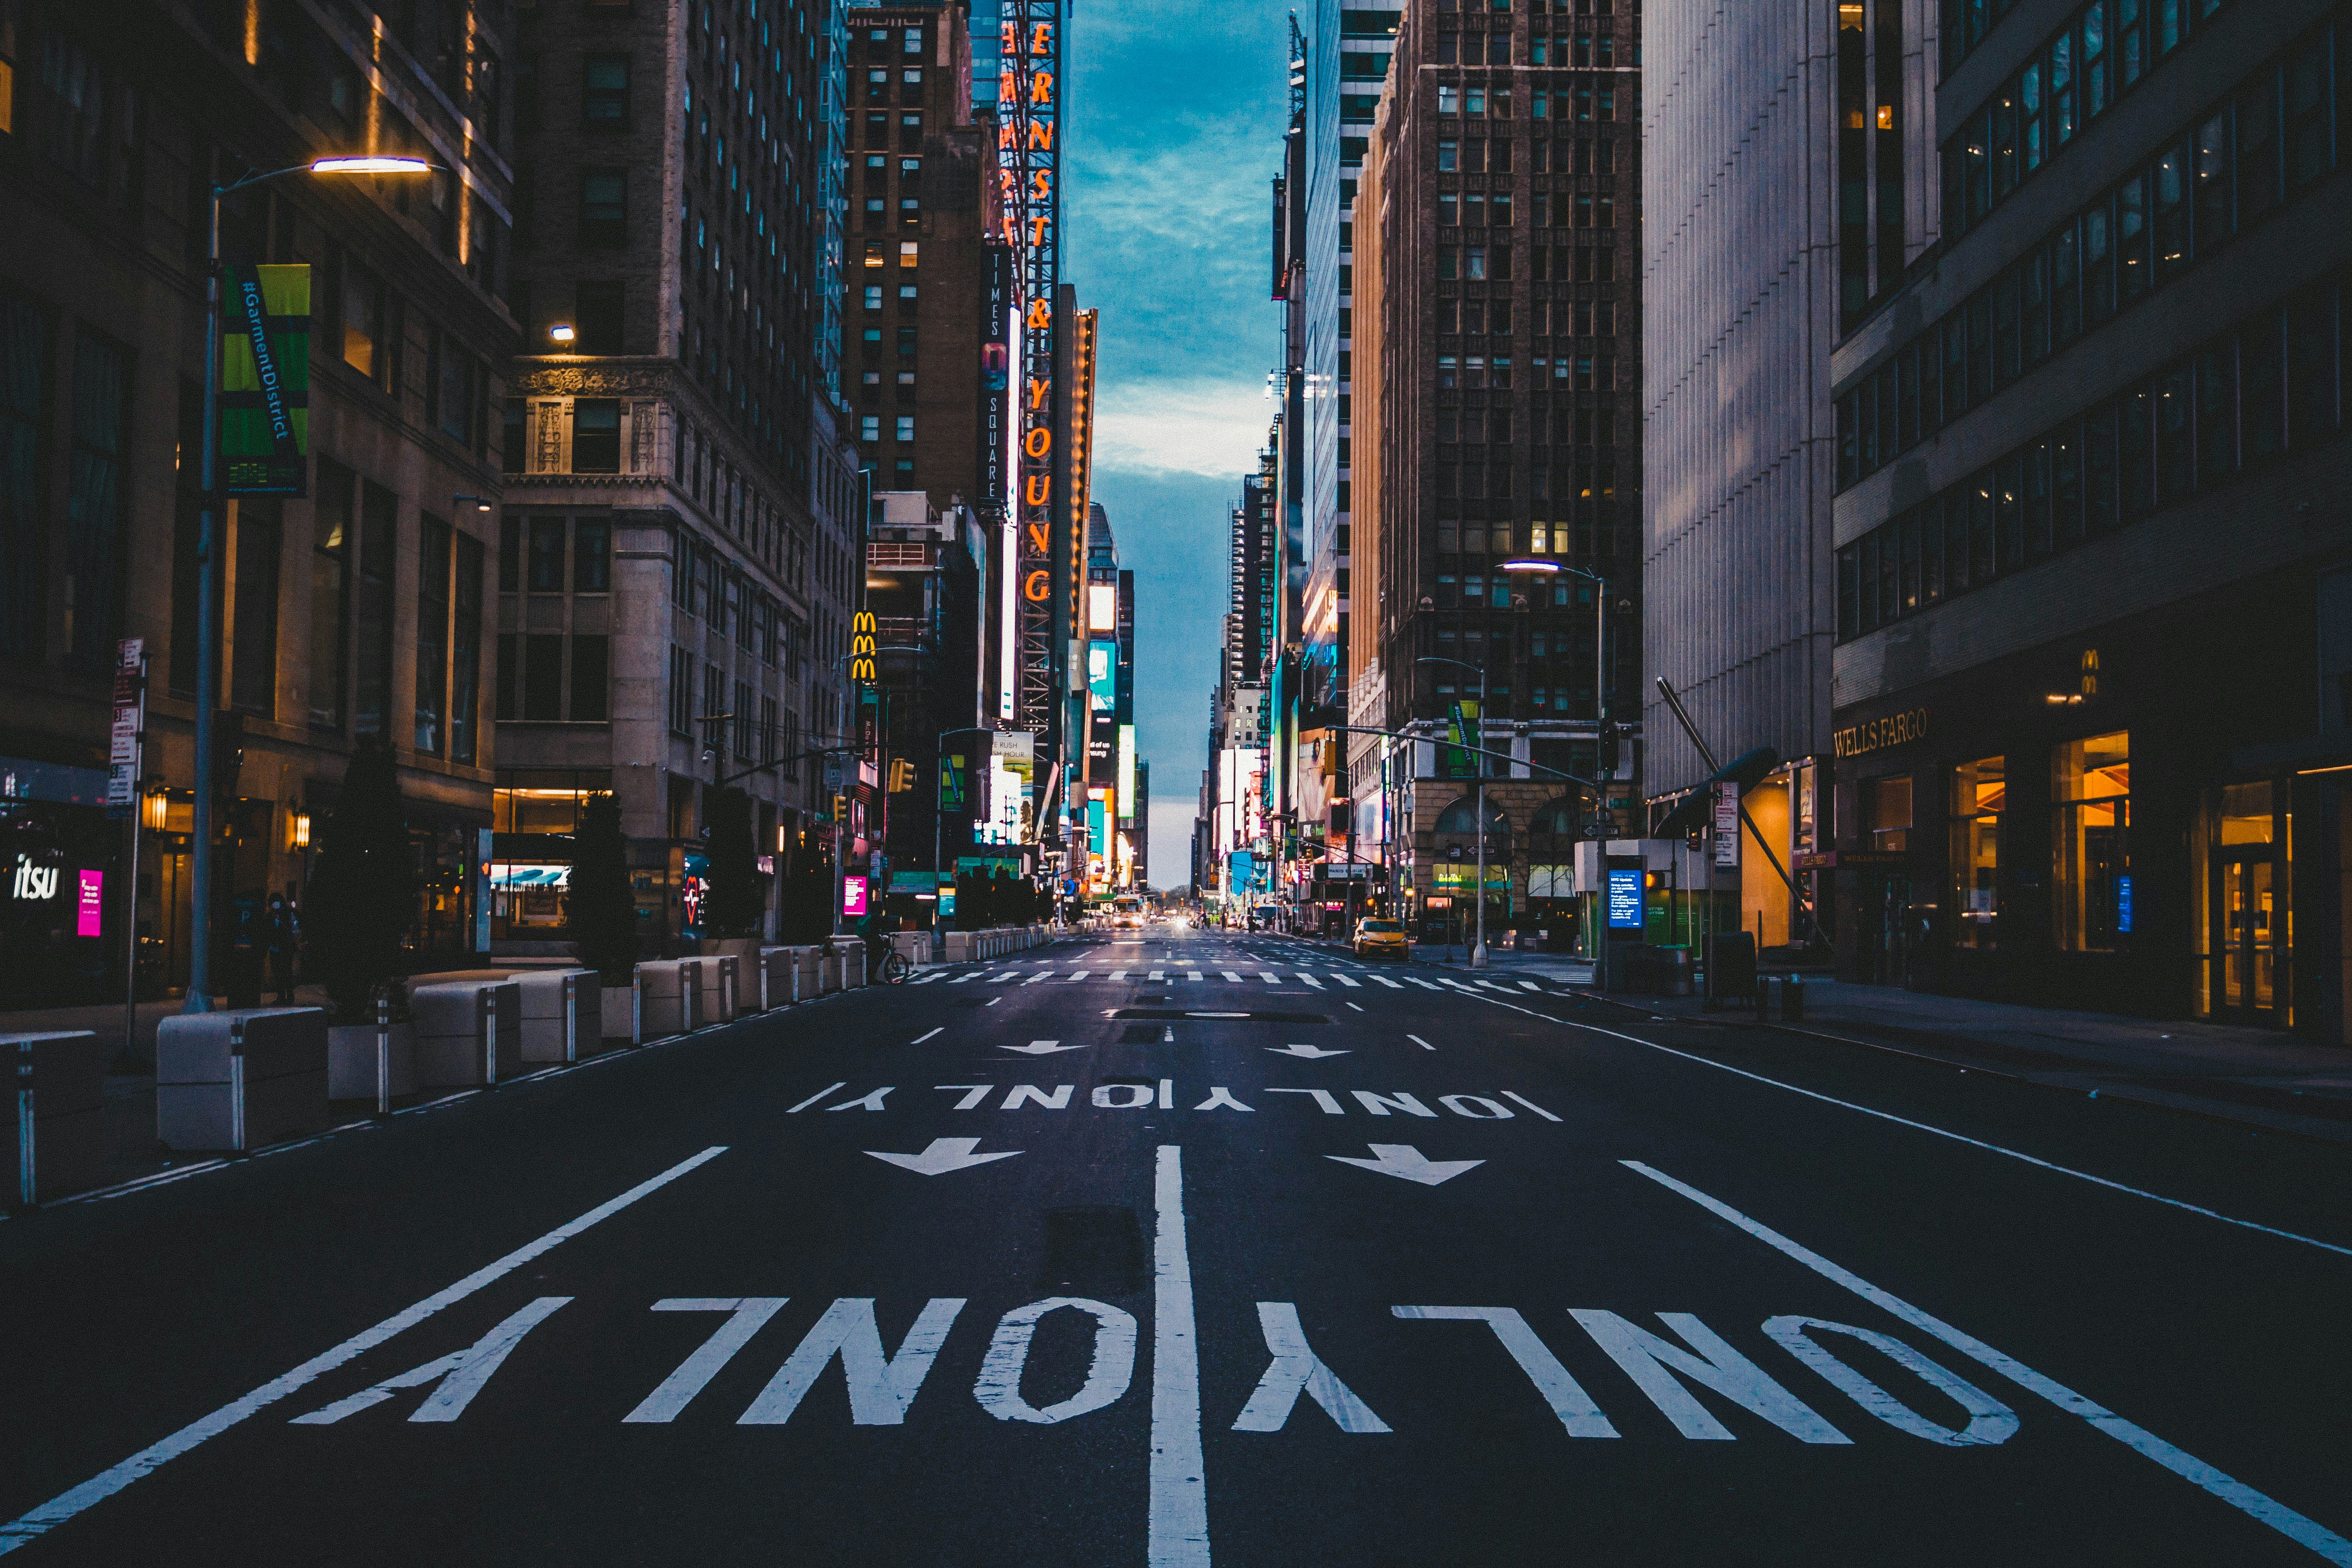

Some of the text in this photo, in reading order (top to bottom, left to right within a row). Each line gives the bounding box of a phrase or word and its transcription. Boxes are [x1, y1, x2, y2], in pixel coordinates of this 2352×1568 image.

[1028, 24, 1054, 246] ERNST
[1027, 298, 1051, 328] &
[243, 281, 288, 439] #GarmentDistrict
[1834, 708, 1926, 759] WELLS FARGO
[14, 853, 59, 899] itsu
[826, 1084, 1154, 1111] ONLY
[1193, 1087, 1516, 1119] ONLY
[289, 1296, 1139, 1425] ONLY
[1231, 1302, 2020, 1447] ONLY
